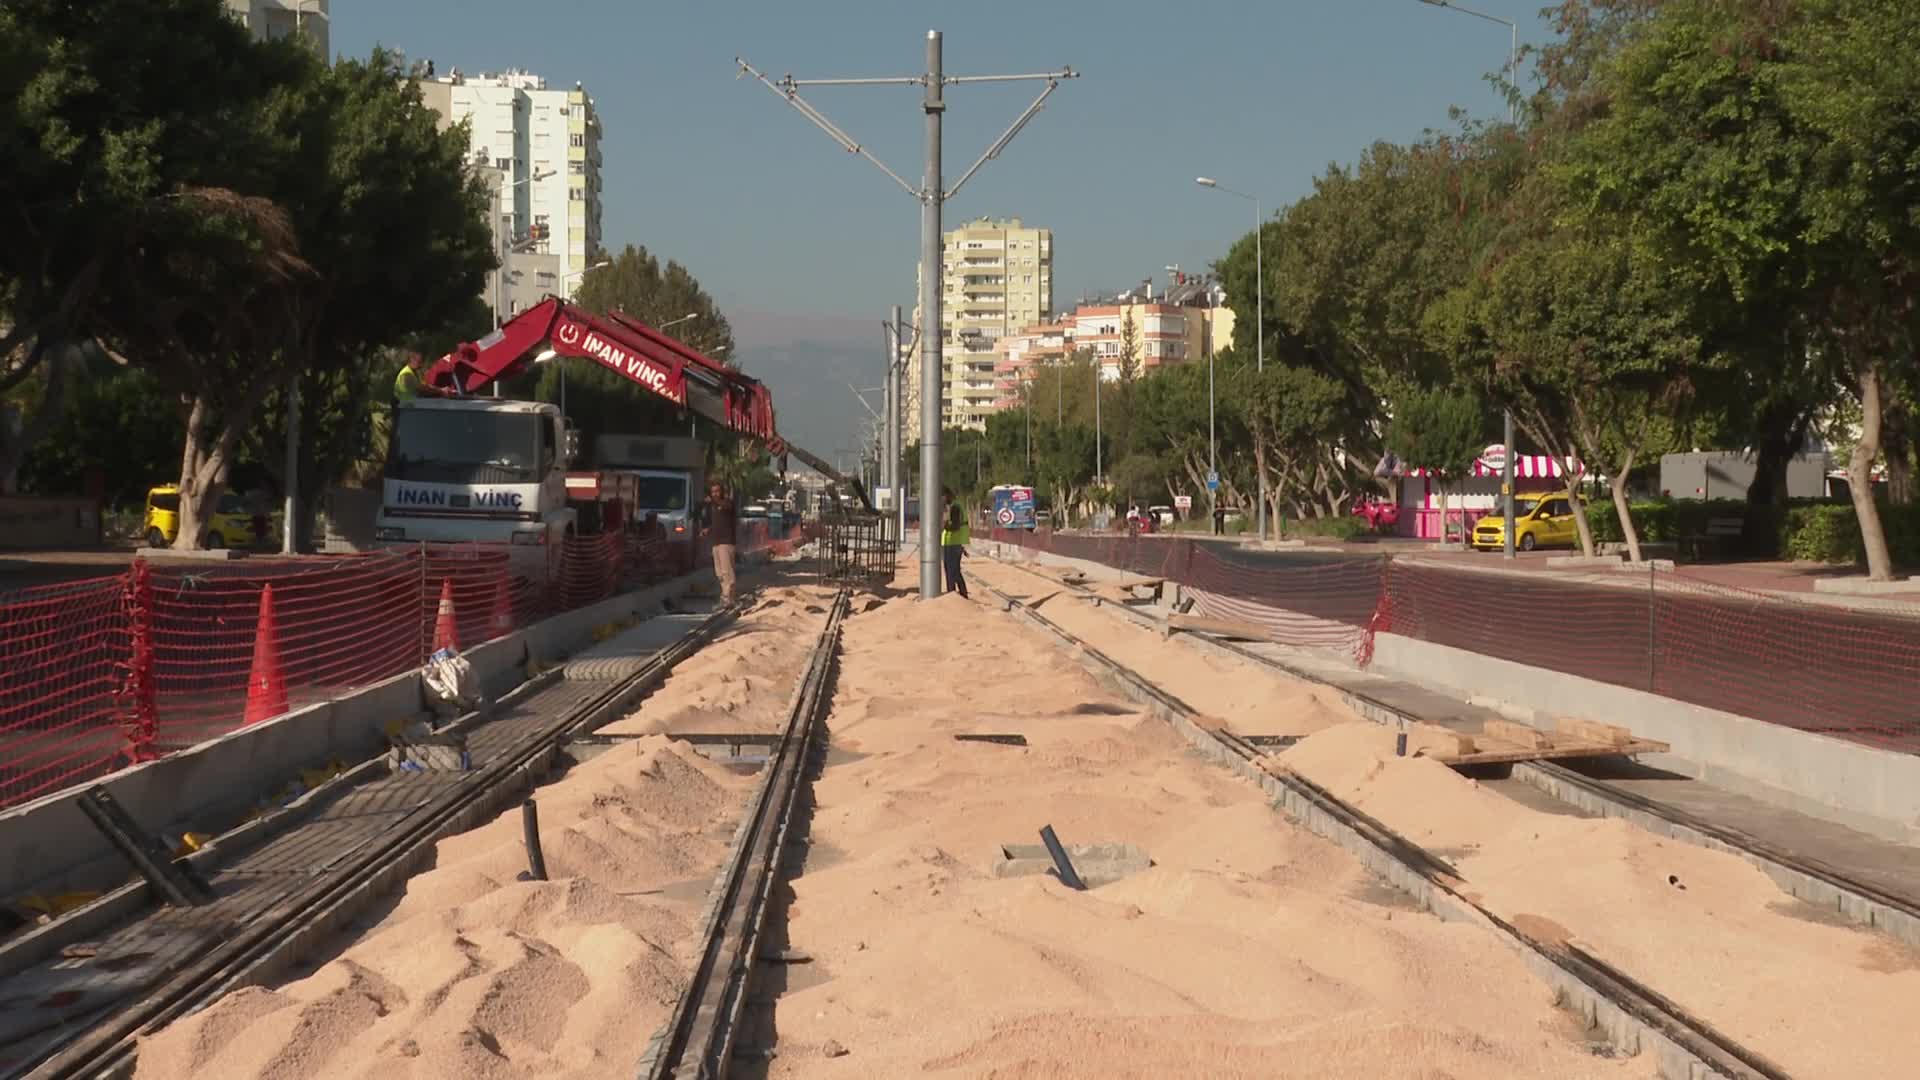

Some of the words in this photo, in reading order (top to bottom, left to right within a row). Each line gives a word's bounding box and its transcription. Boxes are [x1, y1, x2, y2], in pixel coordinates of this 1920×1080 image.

[582, 333, 625, 368] İNAN
[626, 356, 667, 392] VİNÇ
[397, 485, 445, 505] İNAN
[475, 489, 523, 511] VİNÇ
